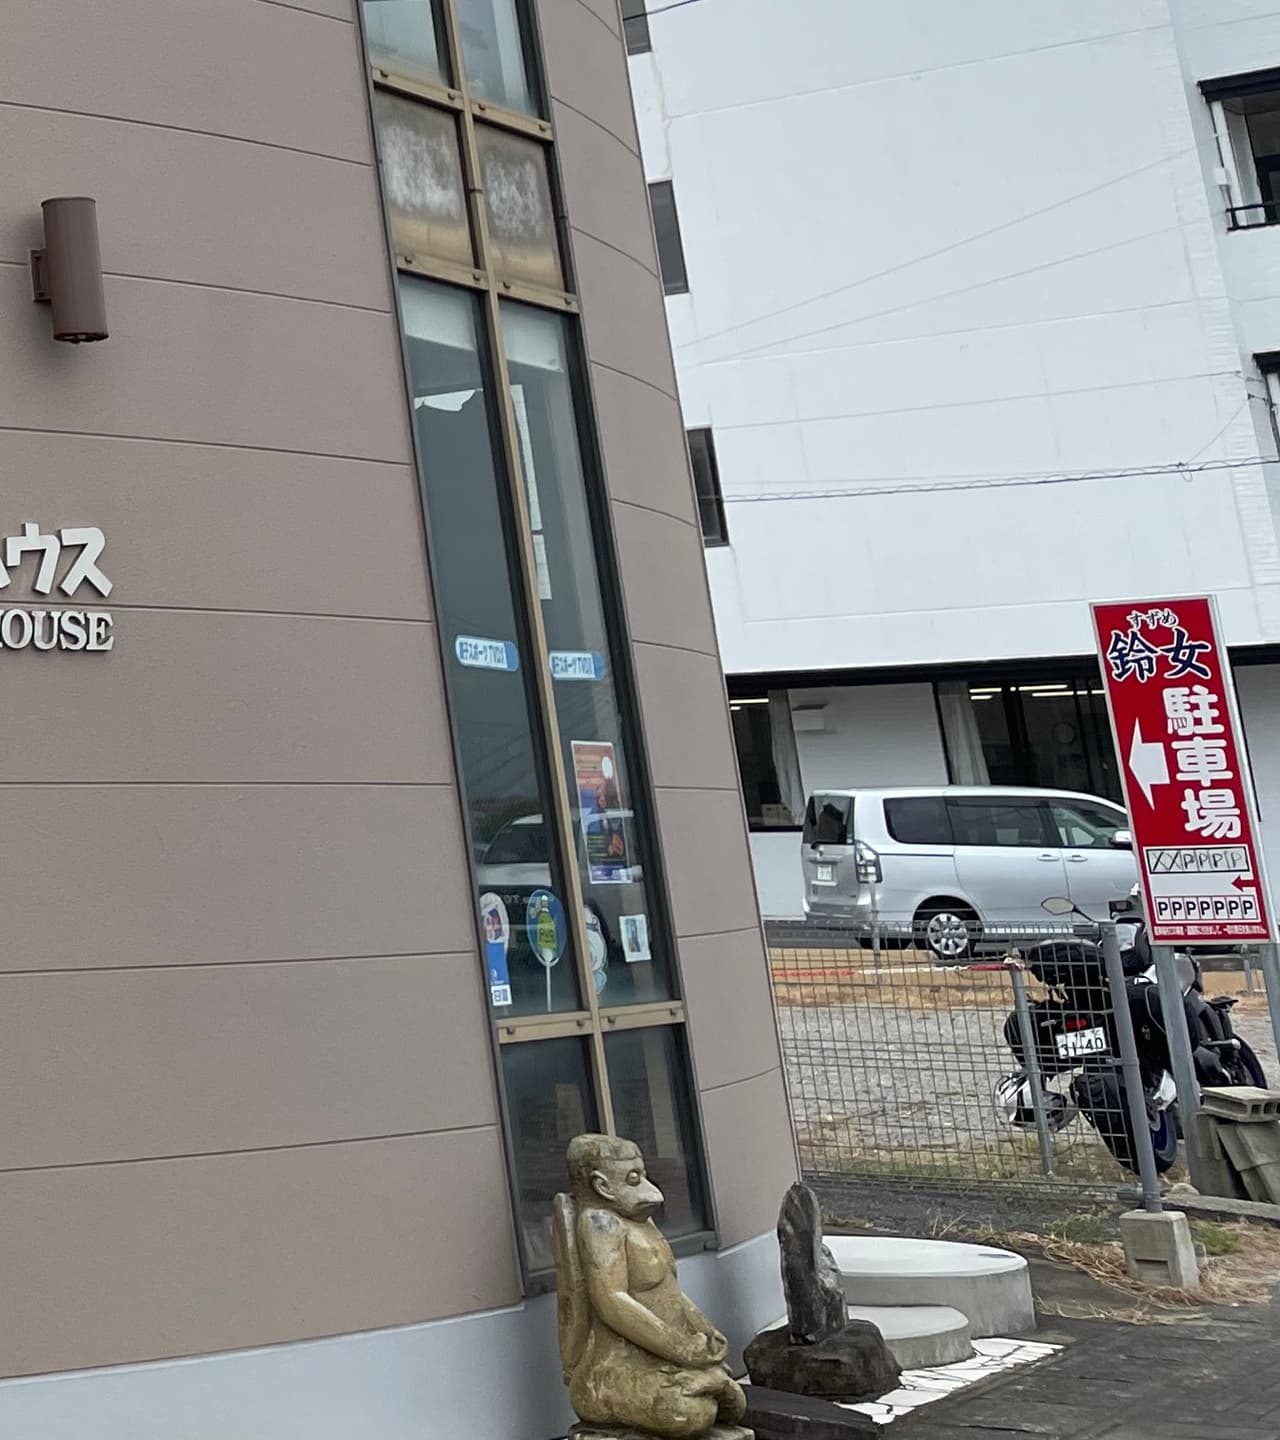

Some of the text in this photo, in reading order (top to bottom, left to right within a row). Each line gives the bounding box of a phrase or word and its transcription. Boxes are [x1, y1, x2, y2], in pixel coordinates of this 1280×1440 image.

[1126, 607, 1179, 630] すずめ
[1107, 627, 1212, 683] 鈴女
[1162, 684, 1242, 840] 駐車場
